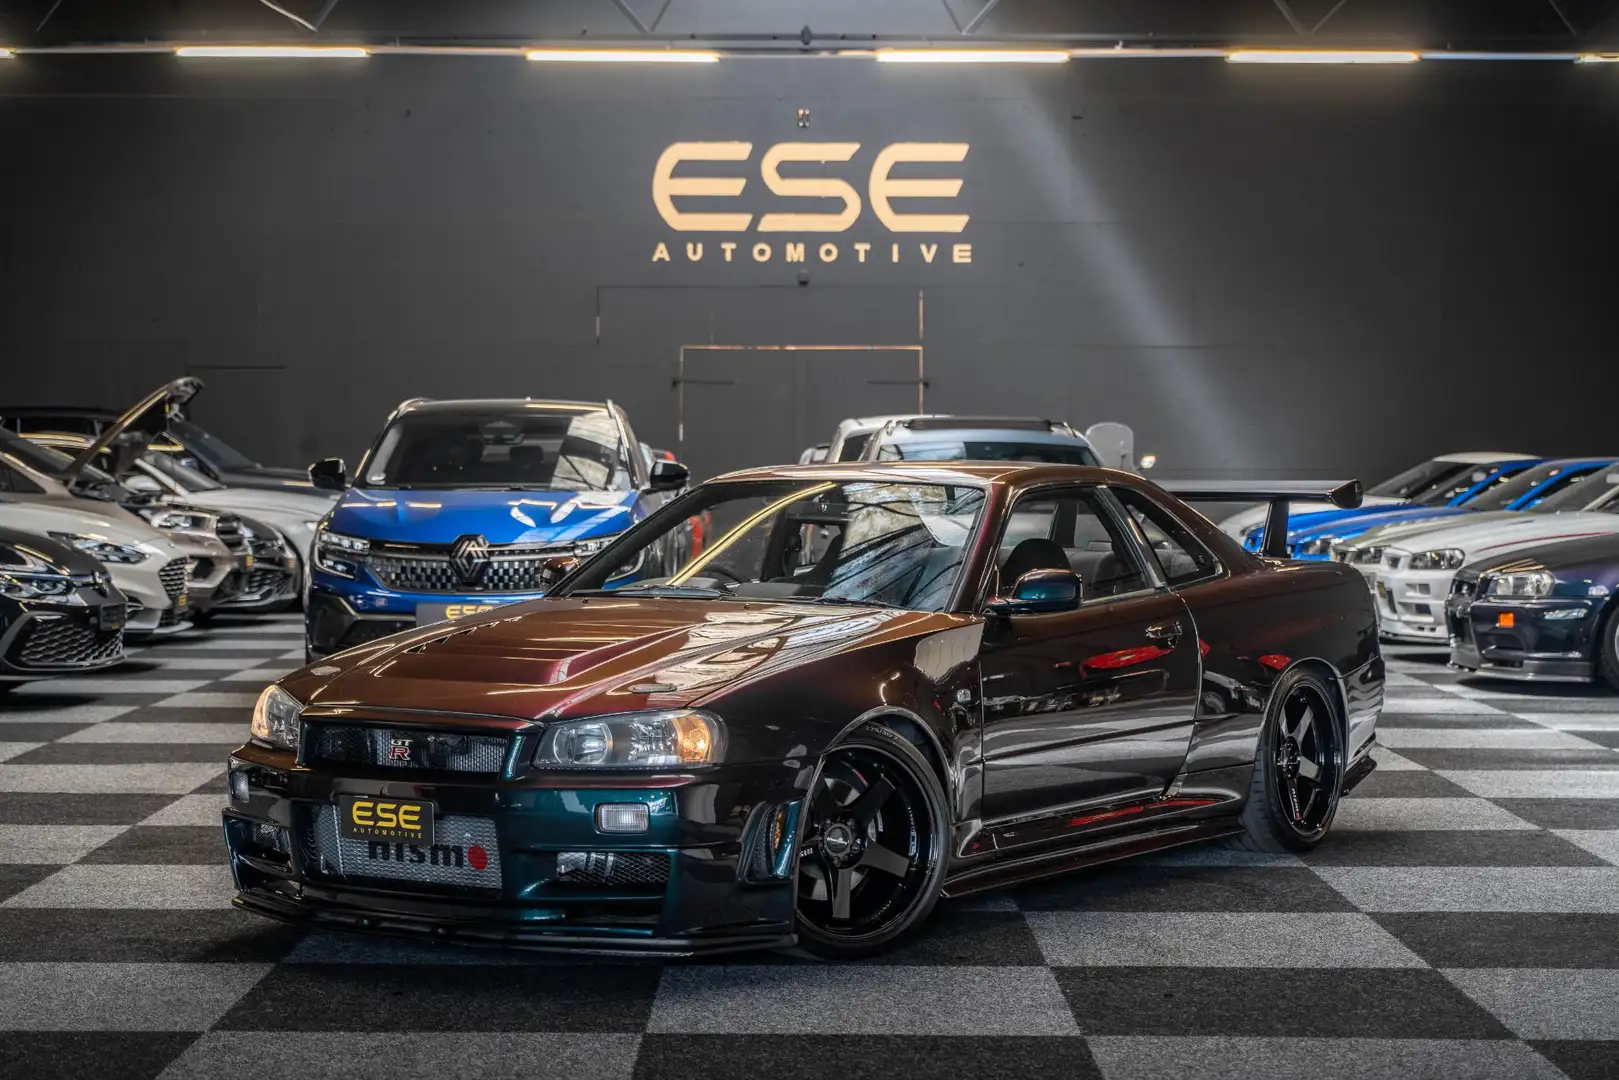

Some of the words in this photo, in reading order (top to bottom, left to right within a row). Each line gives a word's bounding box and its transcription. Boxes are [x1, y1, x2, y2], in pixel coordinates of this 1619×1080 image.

[652, 141, 970, 232] ESE
[652, 242, 973, 263] AUTOMOTIVE
[352, 801, 422, 830] ESE
[353, 827, 423, 839] AUTOMOTIVE
